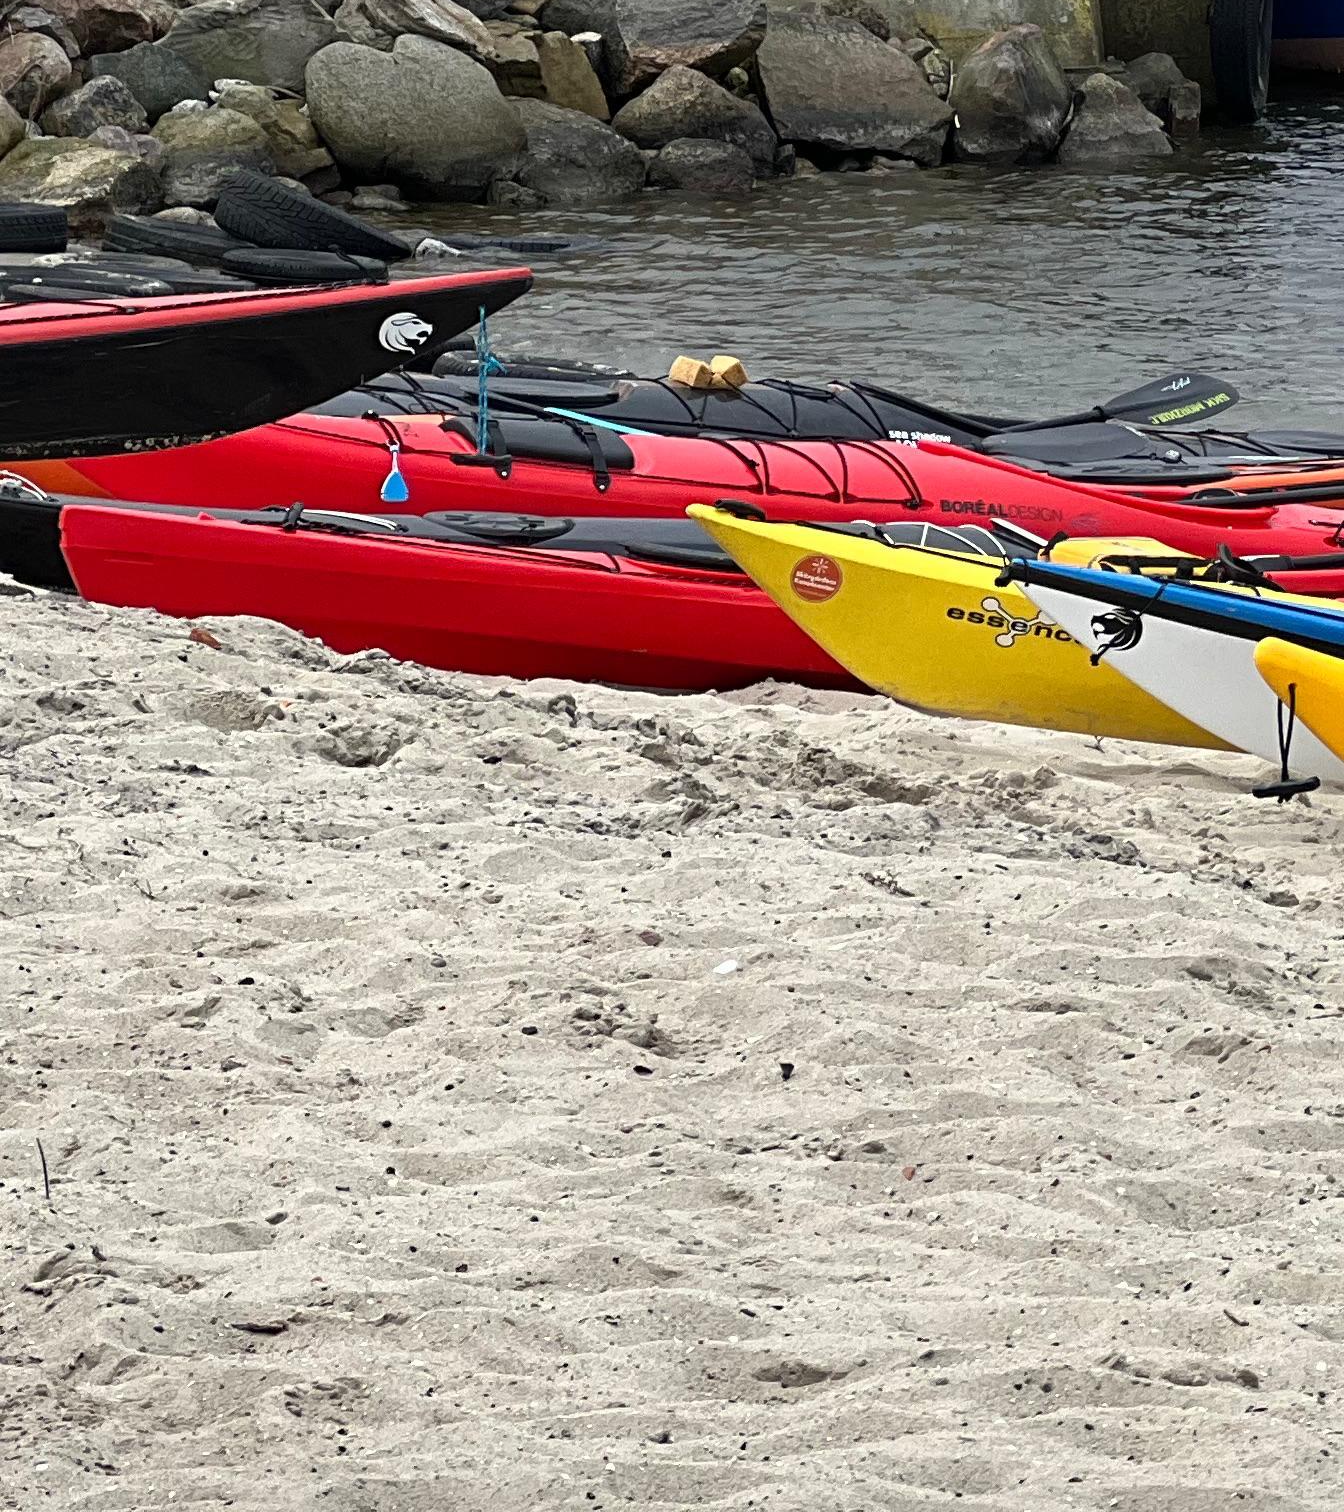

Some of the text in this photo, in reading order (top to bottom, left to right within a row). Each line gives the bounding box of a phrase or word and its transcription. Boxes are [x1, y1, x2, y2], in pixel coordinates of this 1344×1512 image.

[889, 430, 951, 443] sea shadow
[947, 607, 1083, 645] essenc
